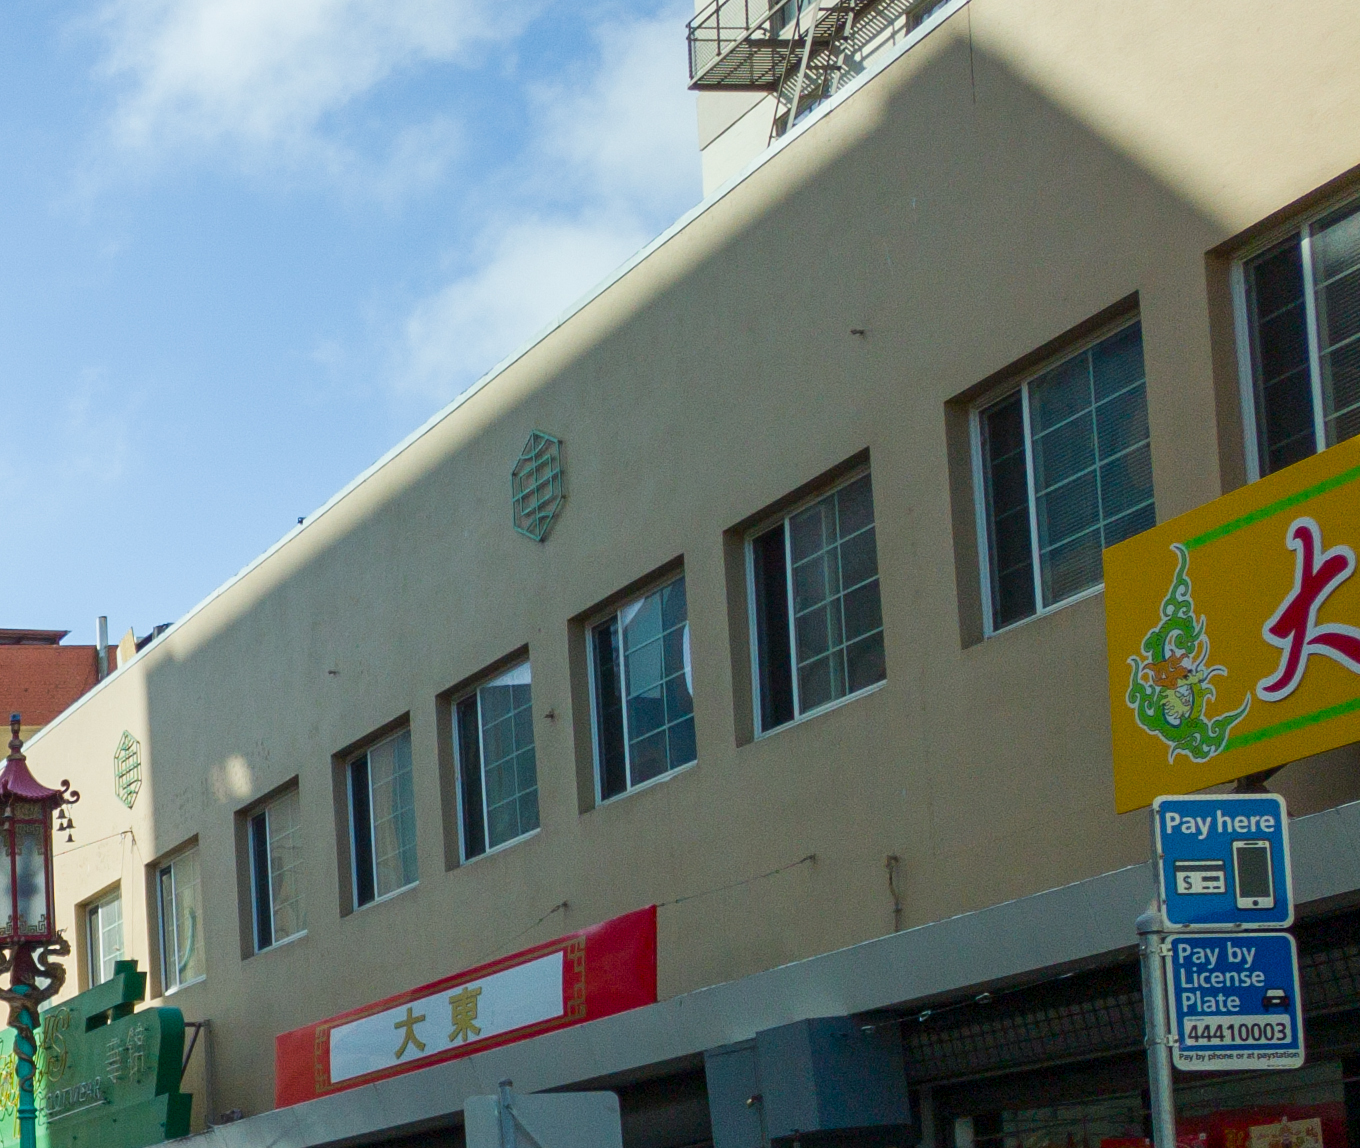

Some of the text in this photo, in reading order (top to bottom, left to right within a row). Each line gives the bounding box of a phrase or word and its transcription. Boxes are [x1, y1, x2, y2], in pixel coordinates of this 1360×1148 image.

[1164, 809, 1276, 840] Pay here
[1177, 941, 1257, 969] Pay by
[1180, 967, 1266, 989] License
[1182, 991, 1241, 1013] Plate
[393, 986, 483, 1060] 大東
[1187, 1022, 1289, 1044] 44410003
[1178, 1049, 1301, 1062] Pay by phone or at paystation
